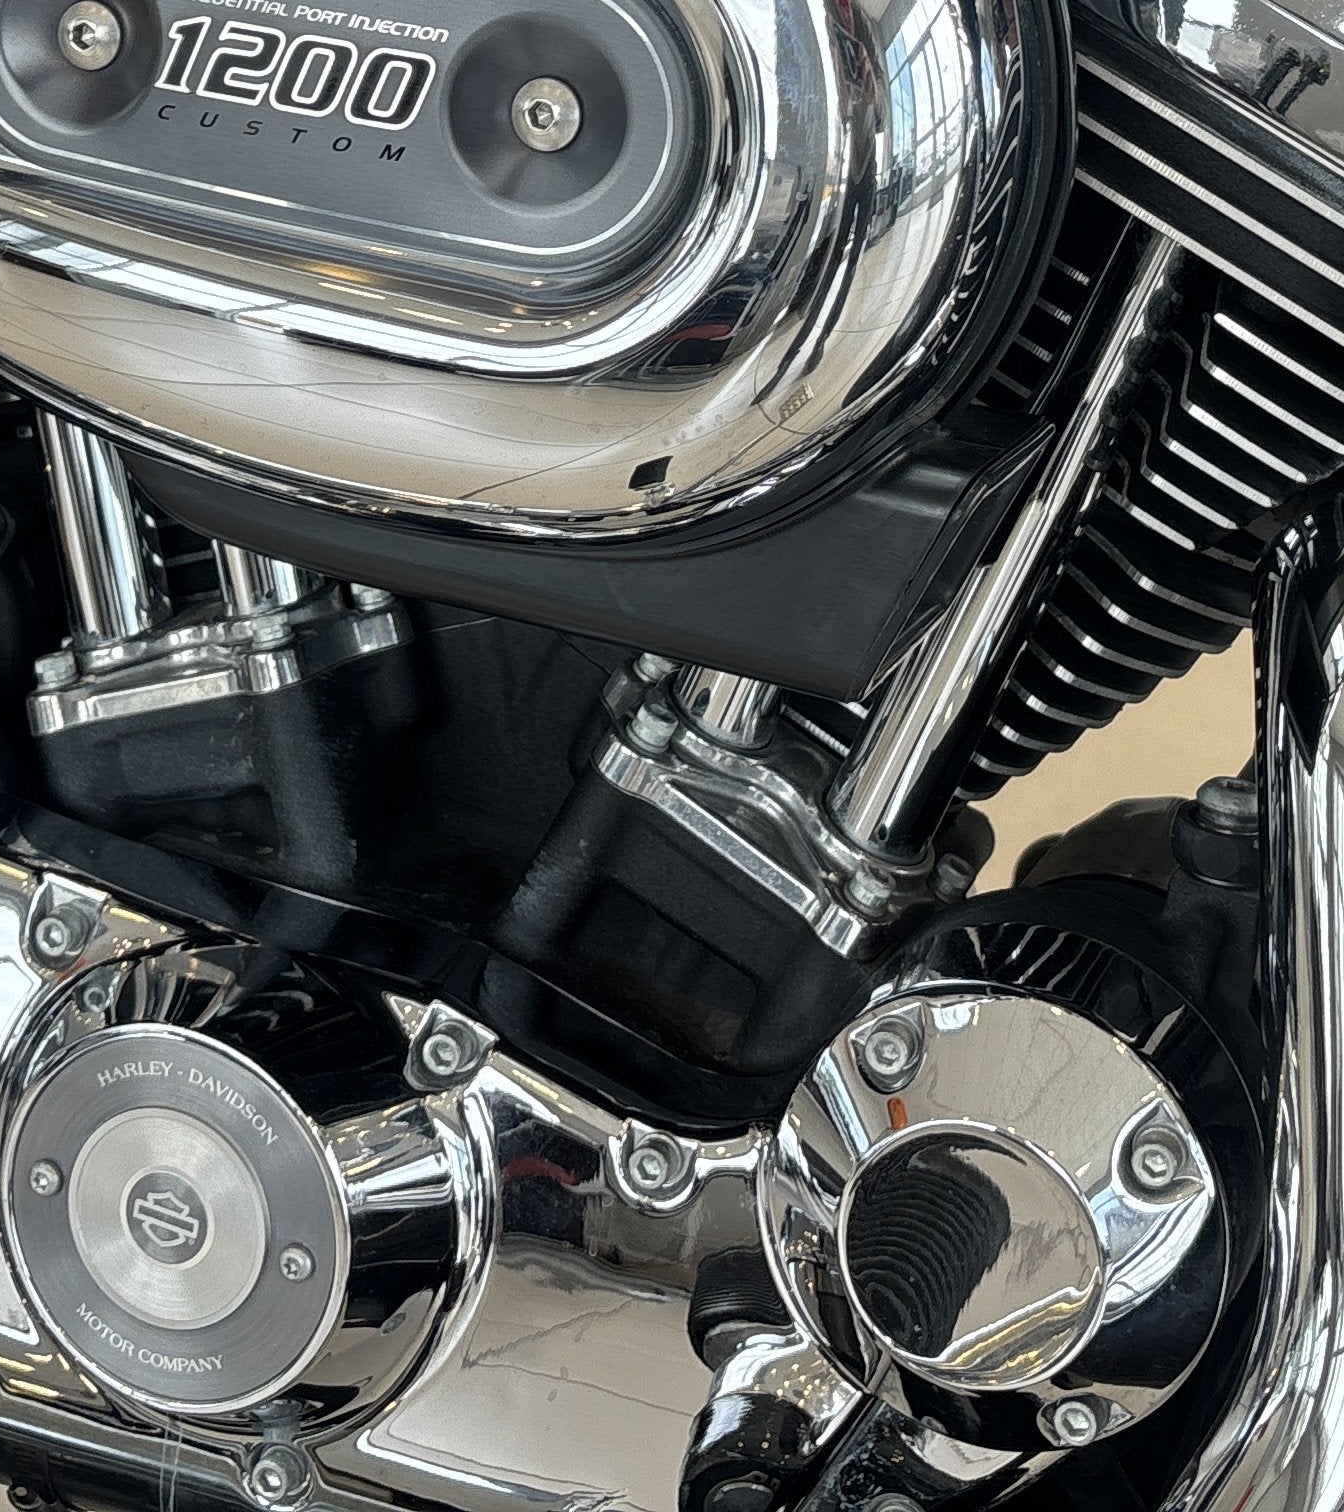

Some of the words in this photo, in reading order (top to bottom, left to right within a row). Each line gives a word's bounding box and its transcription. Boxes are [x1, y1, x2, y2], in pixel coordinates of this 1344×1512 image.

[293, 4, 348, 28] PORT
[347, 13, 450, 43] INJECTION
[154, 15, 437, 131] 1200
[157, 104, 406, 162] CUSTOM
[96, 1060, 174, 1088] HARLEY
[188, 1067, 279, 1146] DAVIDSON
[75, 1302, 135, 1357] MOTOR
[138, 1348, 223, 1373] COMPANY
